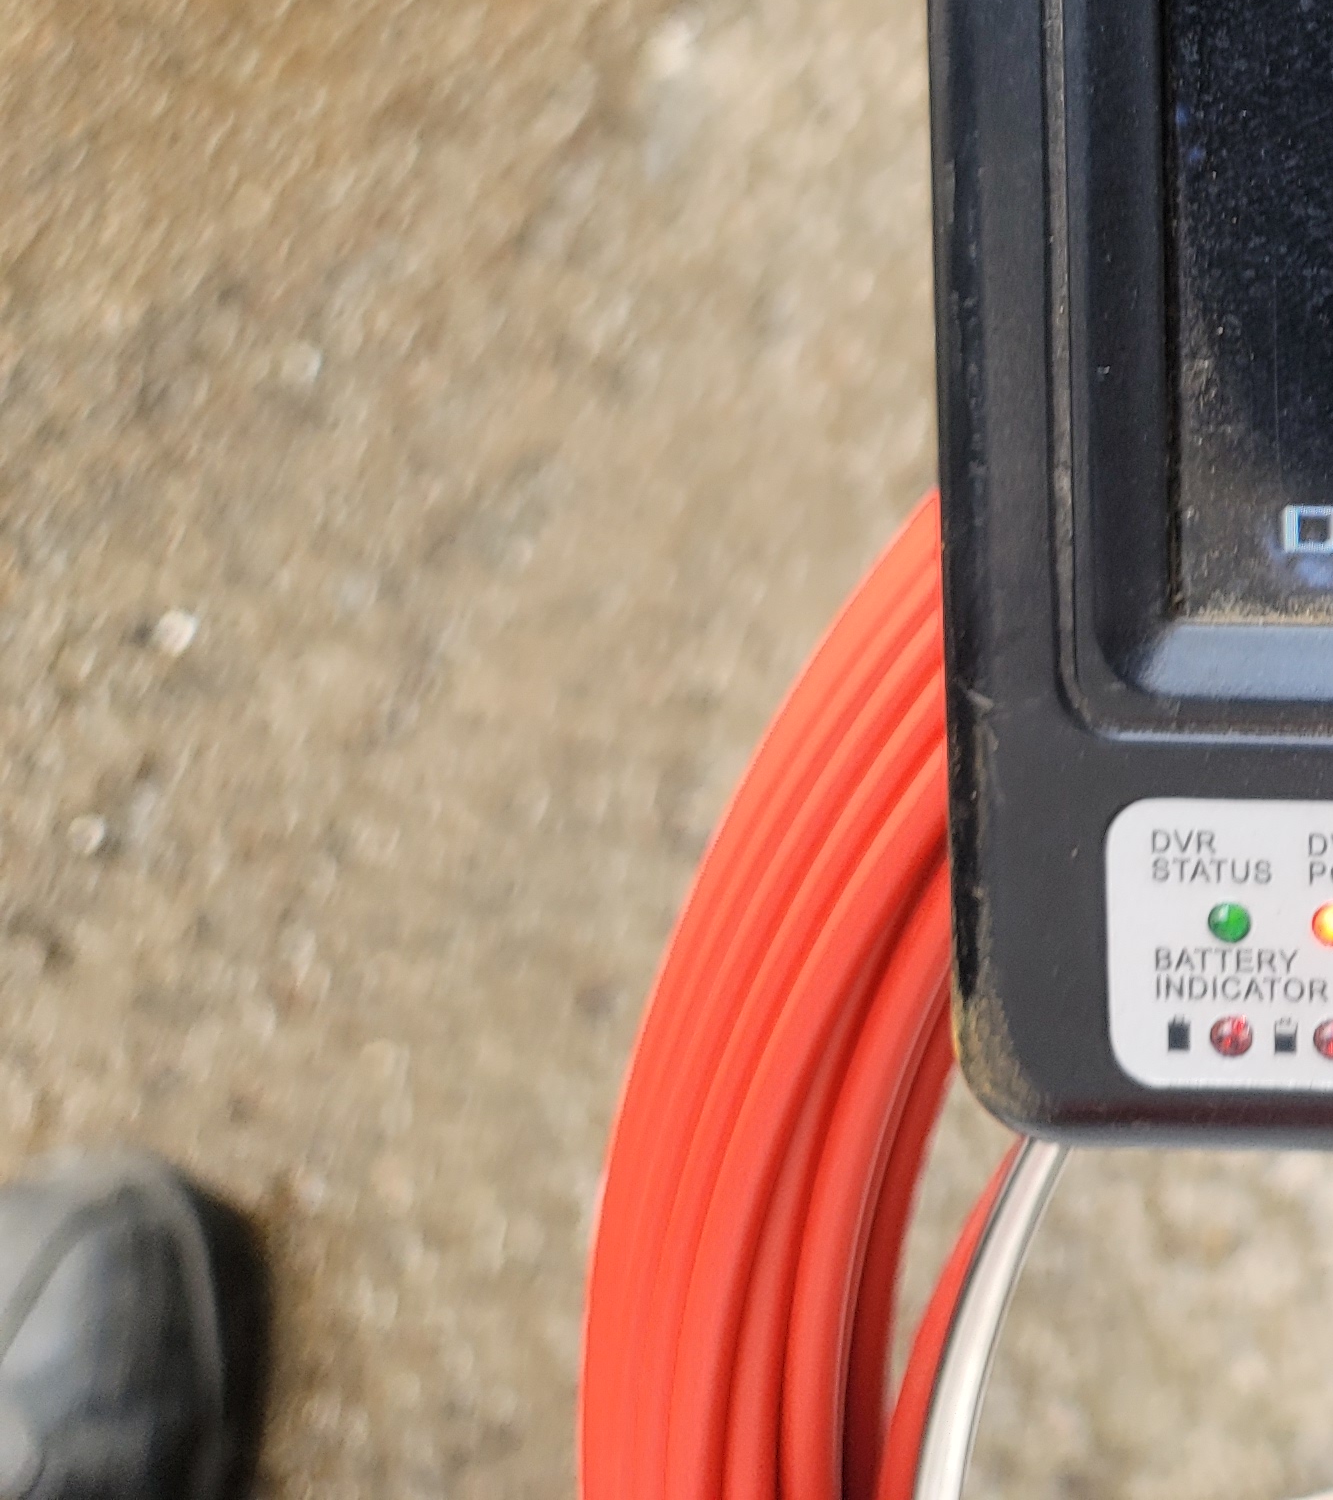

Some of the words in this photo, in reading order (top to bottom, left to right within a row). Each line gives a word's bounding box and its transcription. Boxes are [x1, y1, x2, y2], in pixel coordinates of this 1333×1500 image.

[1151, 830, 1218, 856] DVR
[1151, 858, 1273, 885] STATUS
[1155, 948, 1299, 974] BATTERY
[1155, 976, 1330, 1003] INDICATOR
